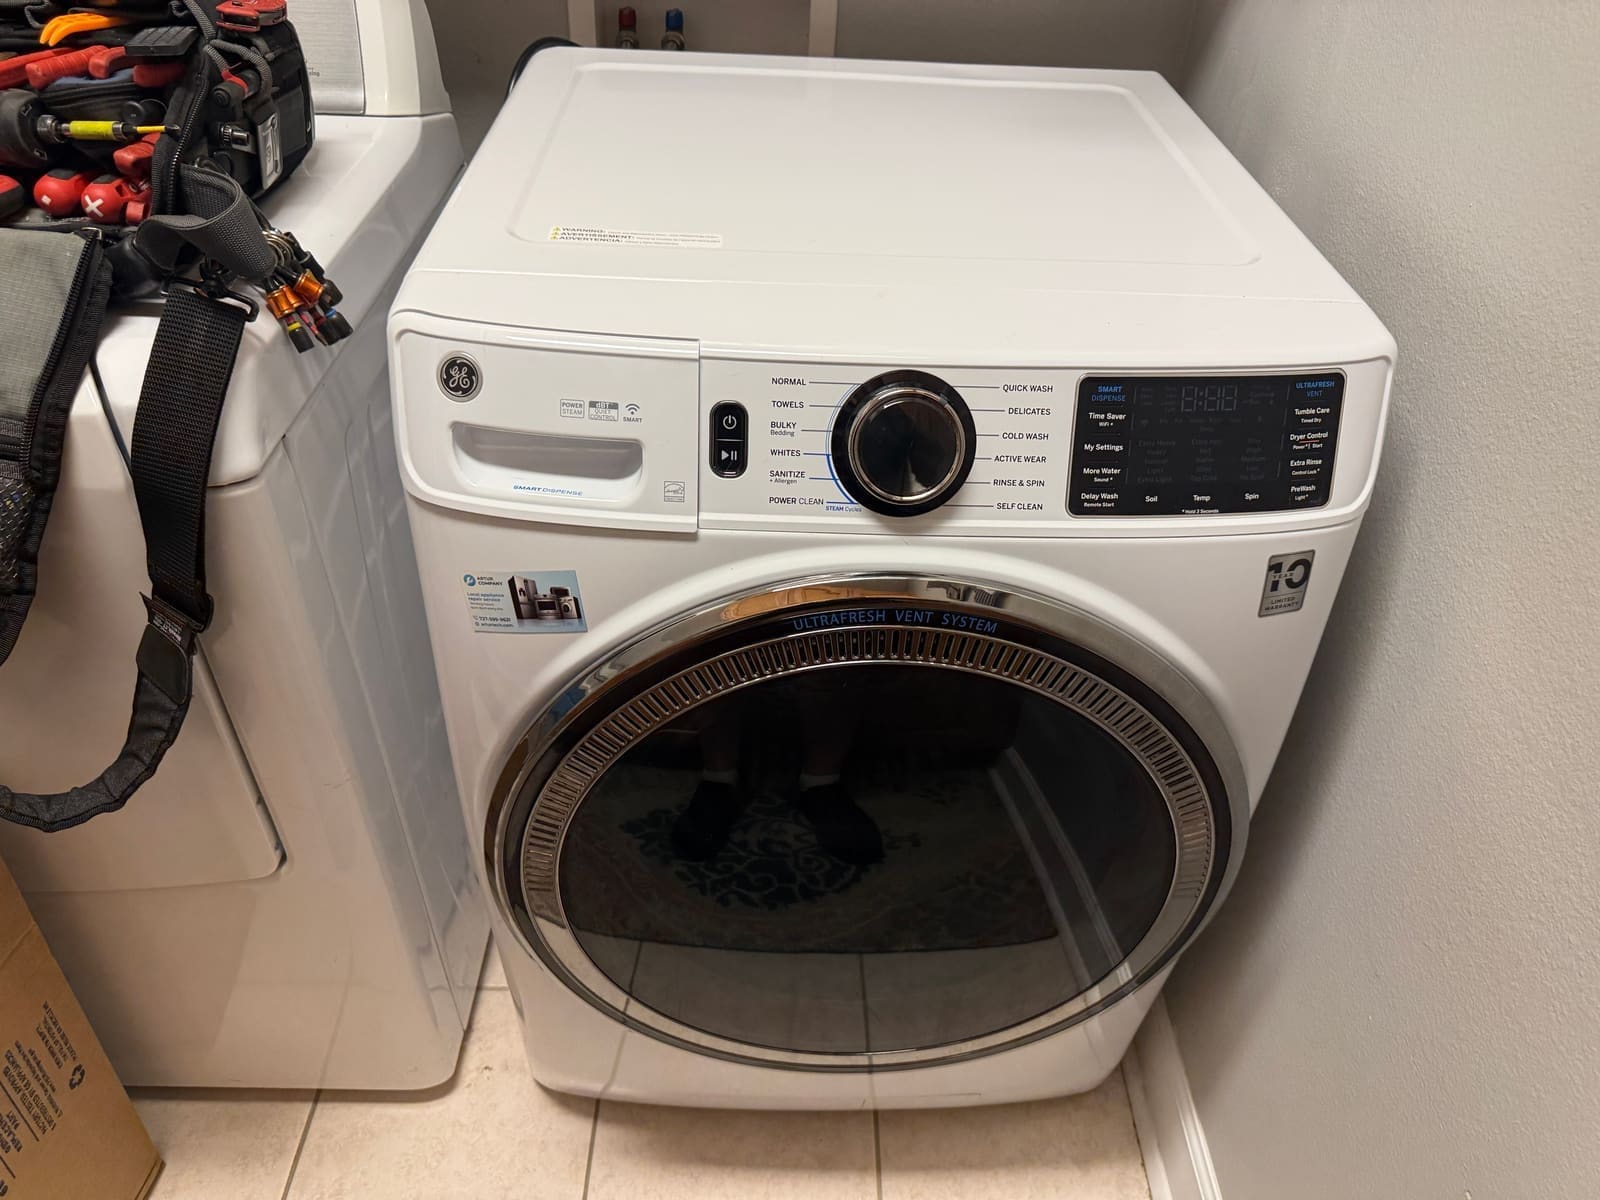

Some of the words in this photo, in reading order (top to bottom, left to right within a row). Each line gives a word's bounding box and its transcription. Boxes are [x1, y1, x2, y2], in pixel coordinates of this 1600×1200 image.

[1003, 384, 1028, 392] QUICK
[1296, 381, 1334, 389] ULTRAFRESH
[772, 401, 804, 409] TOWELS
[1008, 408, 1051, 416] DELICATES
[771, 421, 797, 429] BULKY
[770, 449, 801, 457] WHITES
[770, 471, 806, 479] SANITIZE
[542, 487, 583, 496] DISPENSE
[769, 497, 797, 505] POWER
[1081, 493, 1100, 501] Delay
[1193, 494, 1211, 502] Temp
[1244, 493, 1259, 501] Spin
[793, 610, 886, 631] ULTRAFRESH
[895, 609, 934, 624] VENT
[941, 613, 999, 634] SYSTEM
